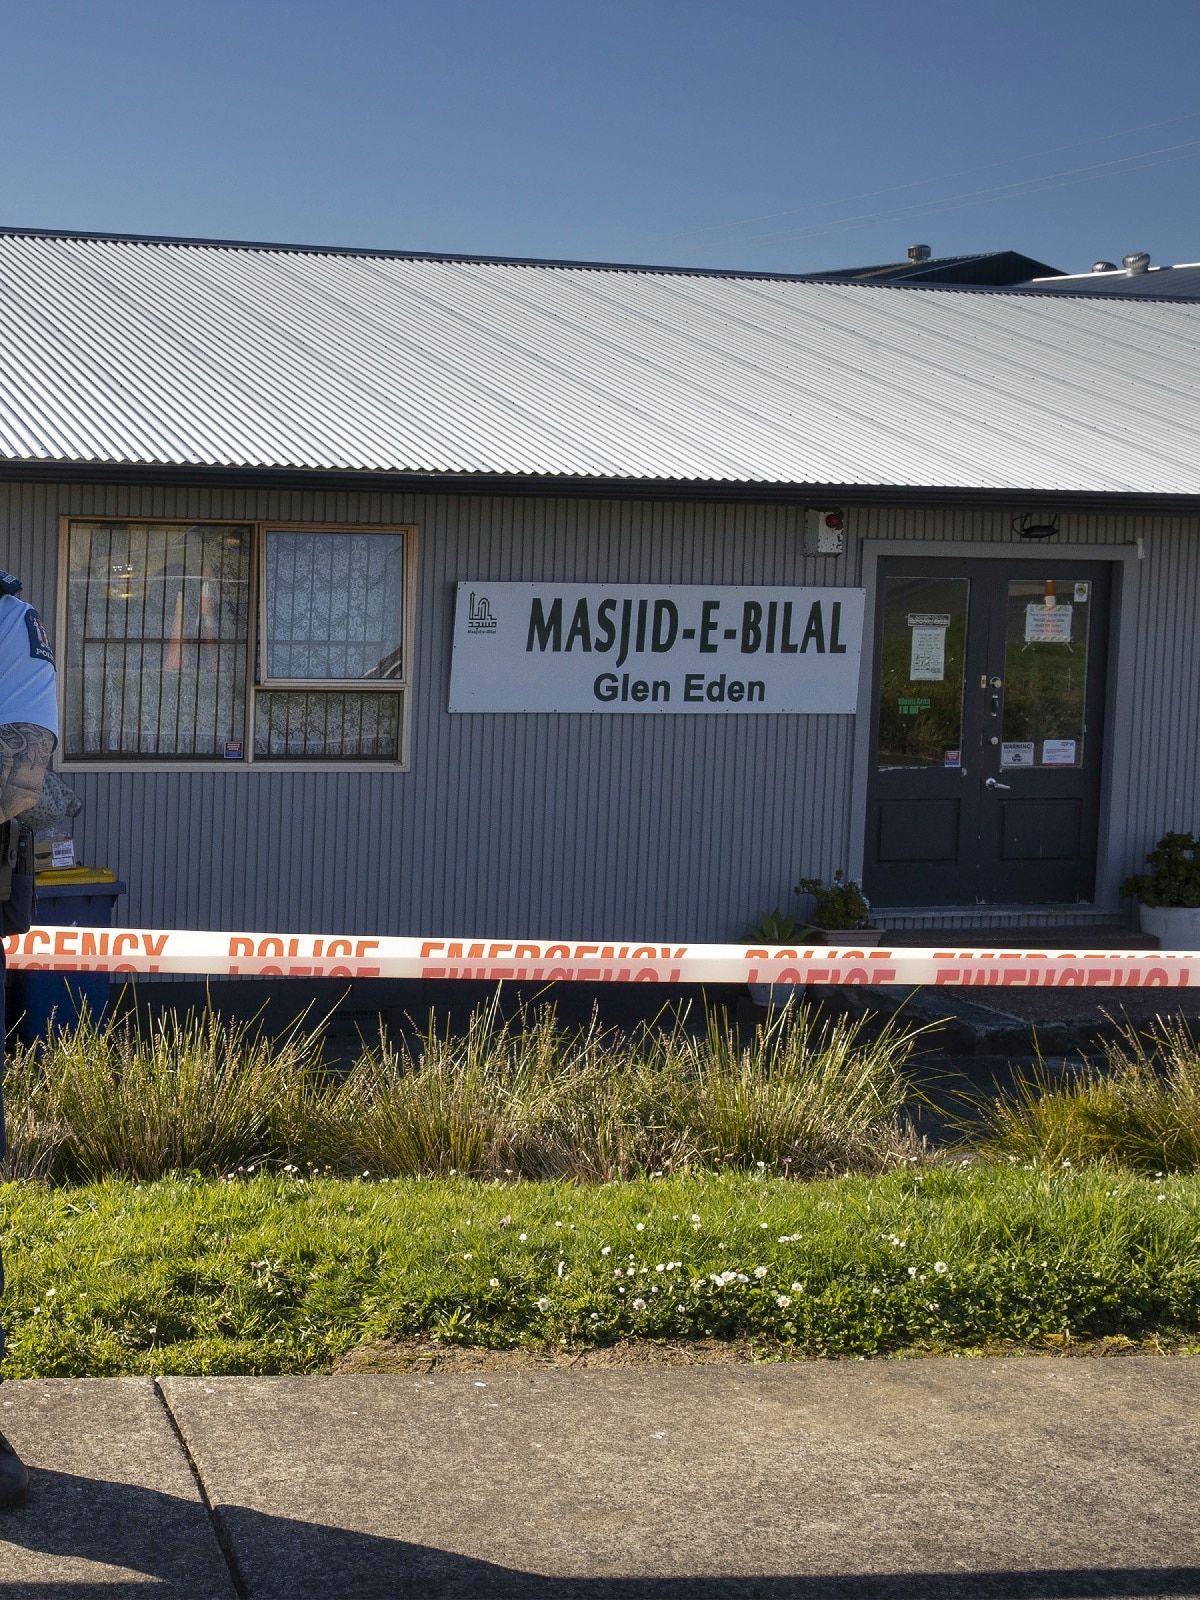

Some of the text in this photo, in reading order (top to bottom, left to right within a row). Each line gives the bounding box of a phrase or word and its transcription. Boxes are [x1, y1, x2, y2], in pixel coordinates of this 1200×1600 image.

[526, 597, 848, 668] MASJID-E-BILAL
[593, 673, 766, 702] Glen Eden
